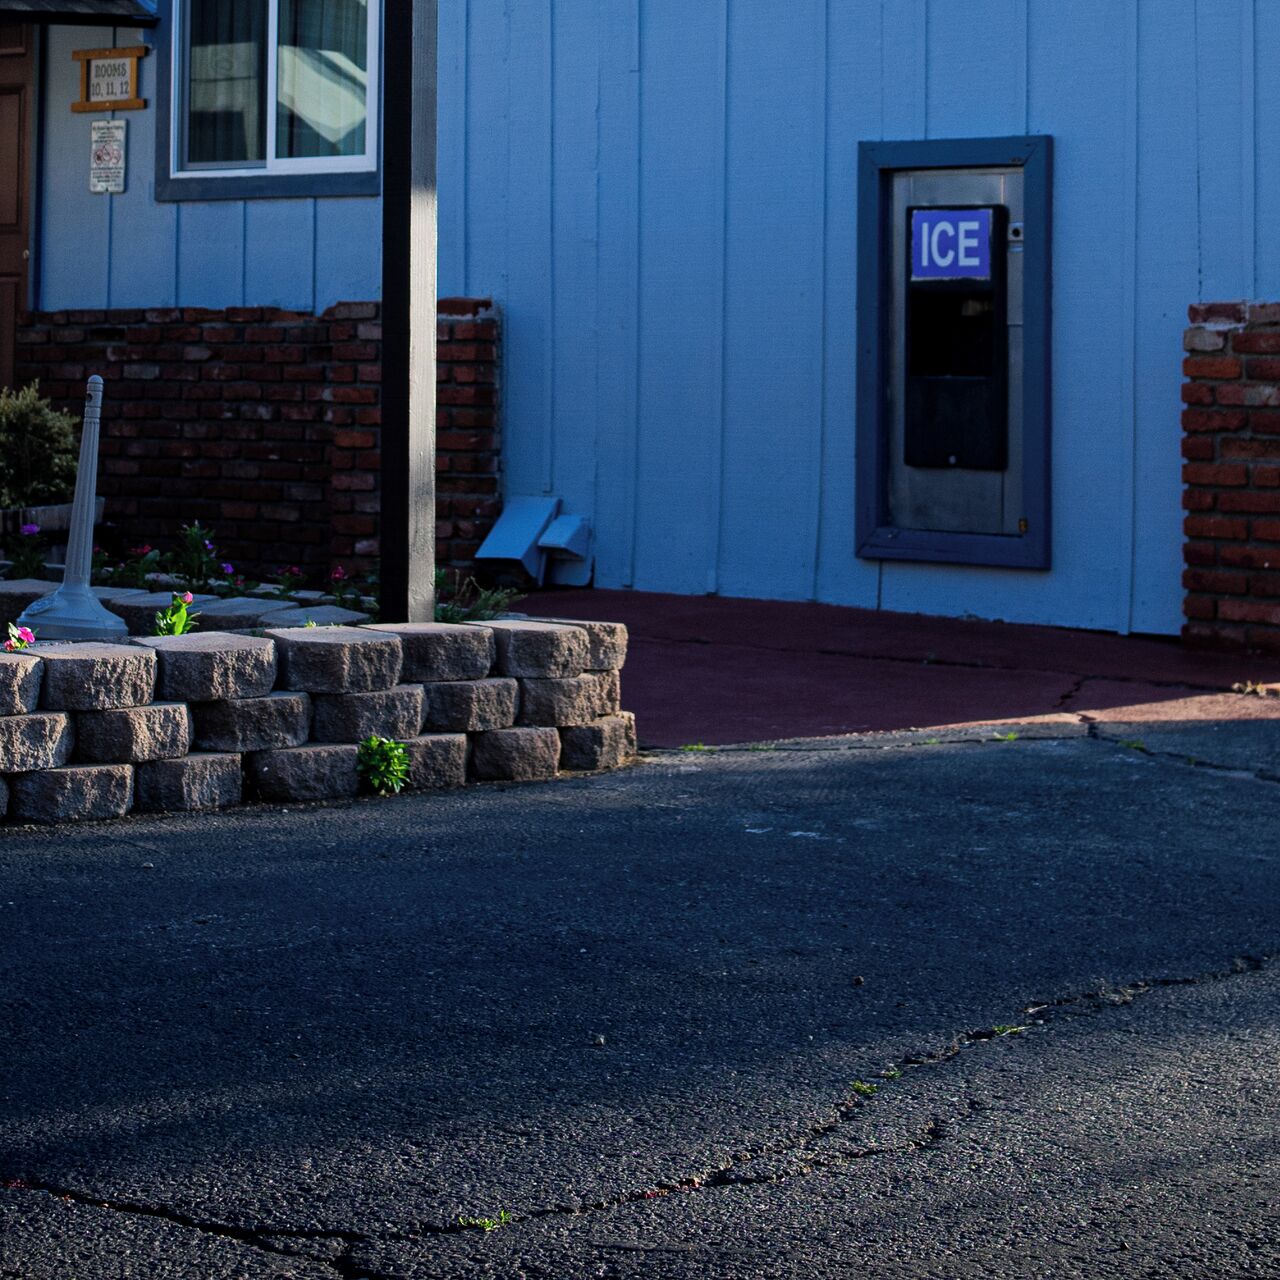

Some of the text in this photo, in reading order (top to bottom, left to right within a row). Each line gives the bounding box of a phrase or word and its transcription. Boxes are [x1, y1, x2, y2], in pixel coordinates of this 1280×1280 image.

[94, 61, 127, 78] ROOMS
[91, 80, 129, 97] 10, 11, 12
[921, 221, 980, 267] ICE
